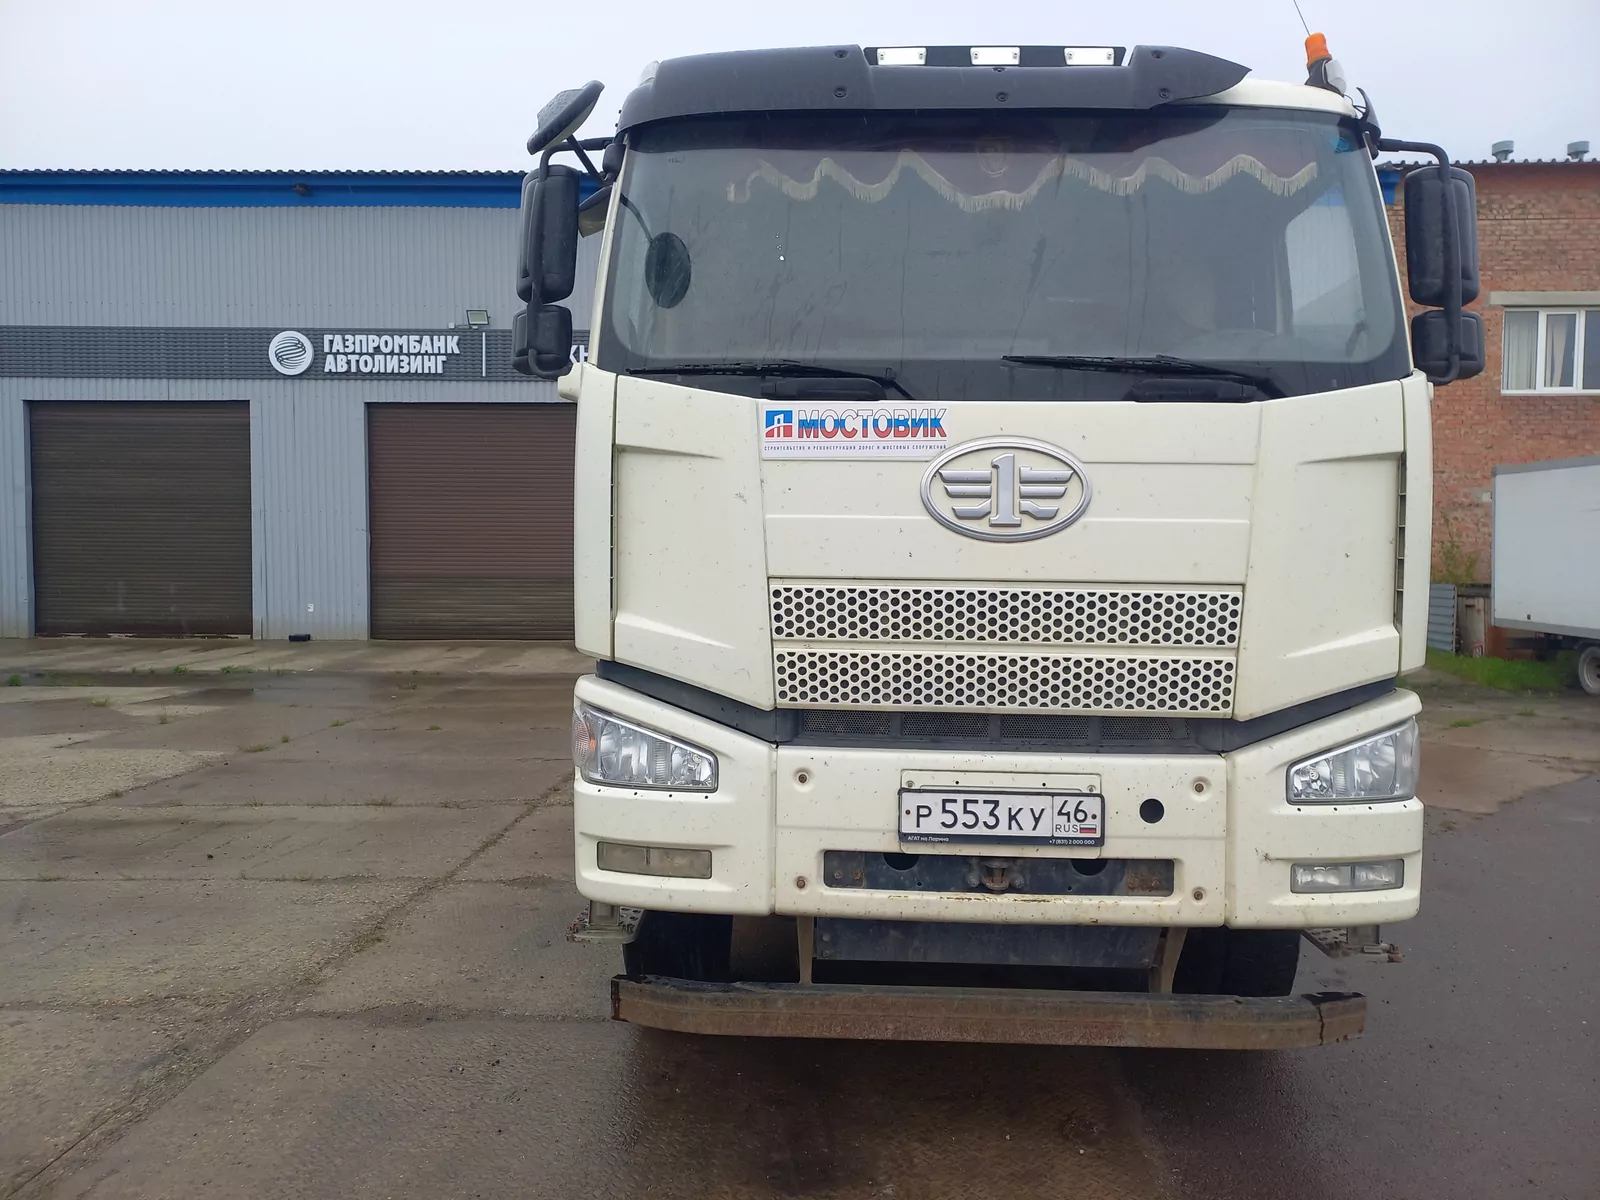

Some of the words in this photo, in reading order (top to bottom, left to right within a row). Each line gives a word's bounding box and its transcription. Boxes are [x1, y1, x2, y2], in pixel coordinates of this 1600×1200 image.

[323, 335, 460, 354] ГАЗПРОМБАНК
[324, 356, 447, 374] АВТОЛИЗИНГ
[798, 409, 947, 439] МОСТОВИК
[1057, 800, 1089, 823] 46
[1055, 824, 1079, 833] RUS
